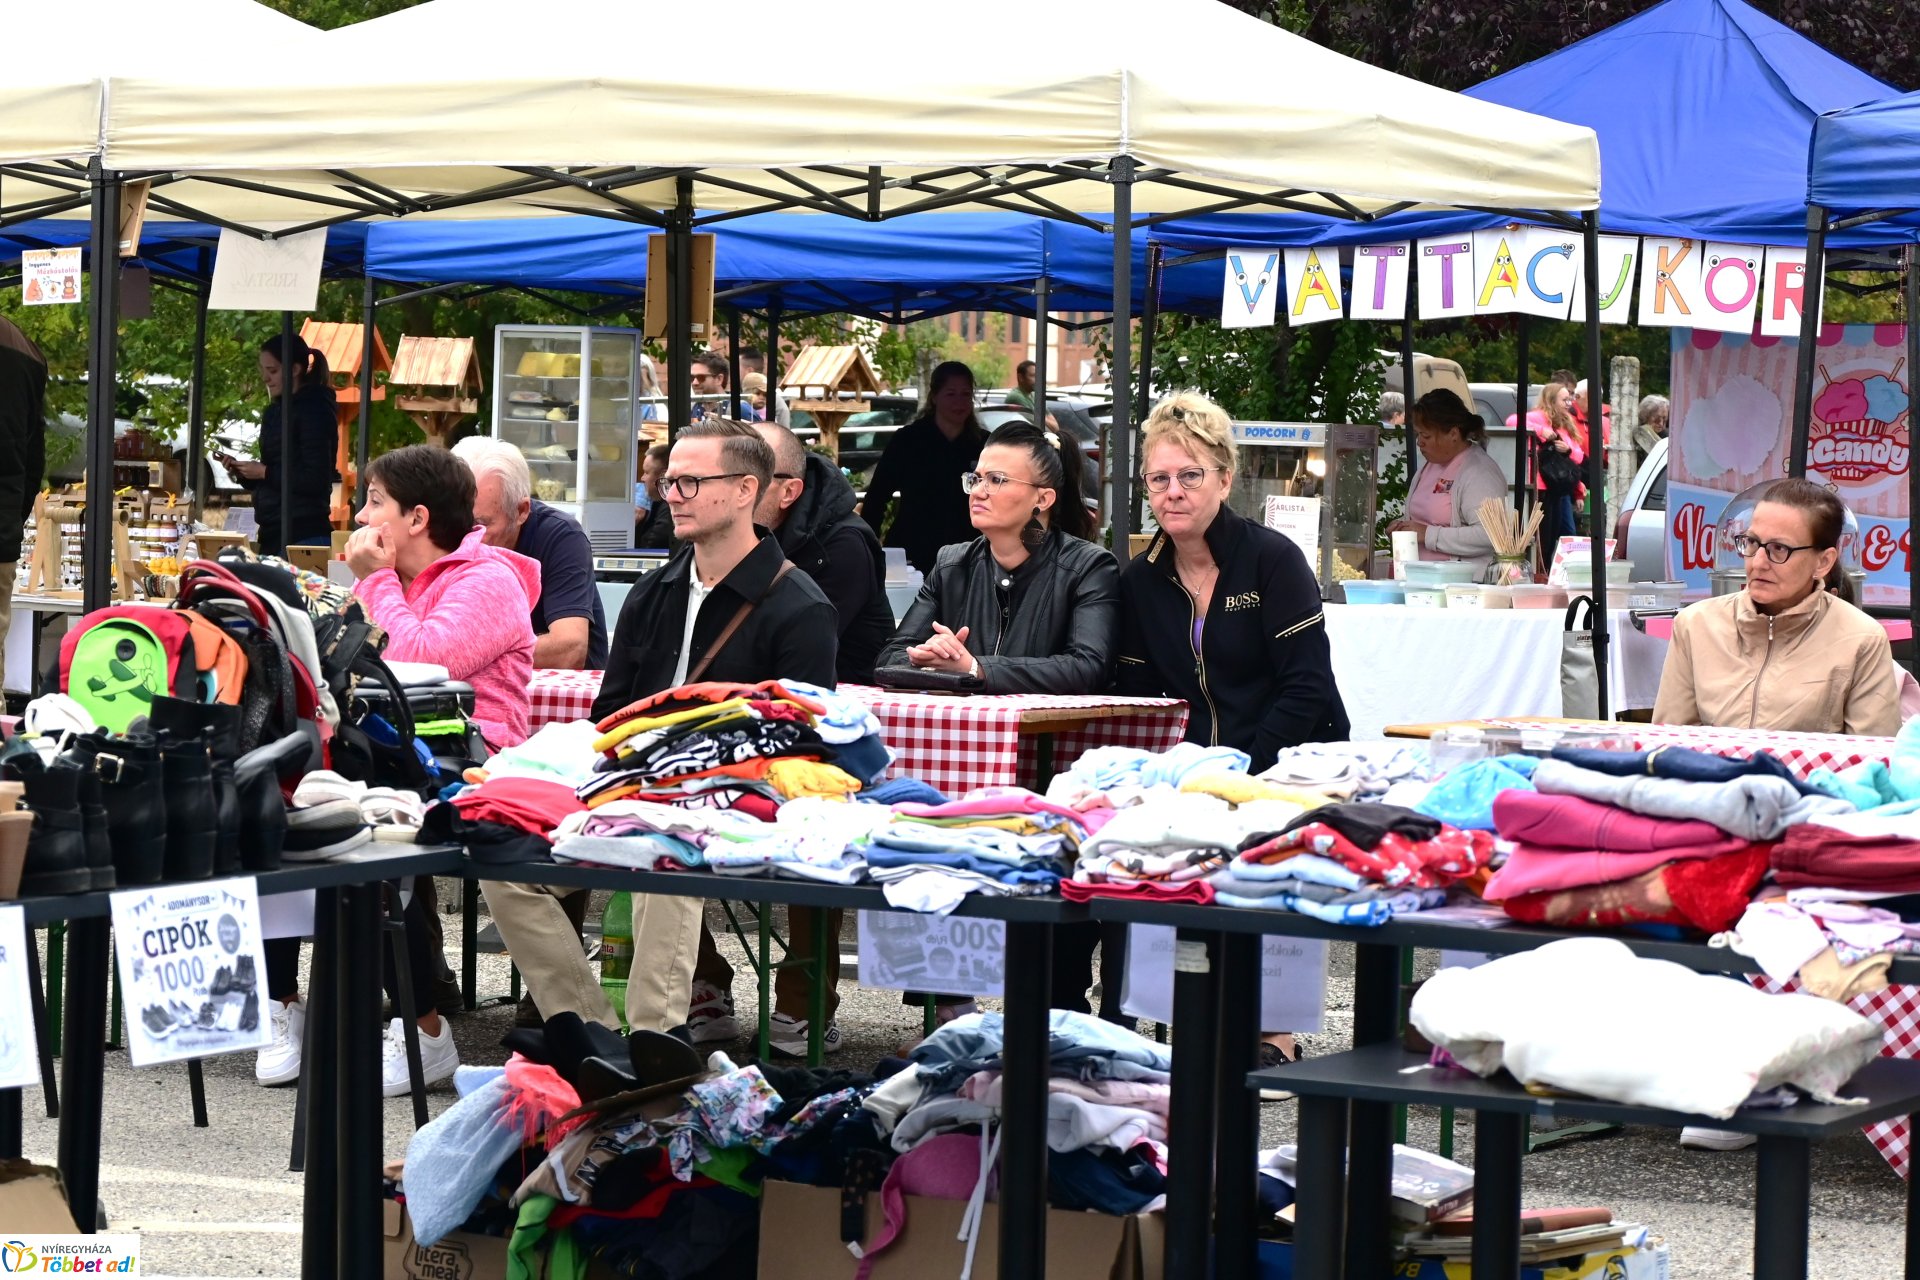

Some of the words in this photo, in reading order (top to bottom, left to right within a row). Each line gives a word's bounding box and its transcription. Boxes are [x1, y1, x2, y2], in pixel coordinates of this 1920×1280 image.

[1229, 236, 1806, 321] VATTACUKOR
[1245, 427, 1296, 438] POPCORN
[1225, 591, 1260, 608] BOSS
[142, 916, 213, 958] CIPŐK
[153, 955, 205, 993] 1000
[421, 1263, 461, 1280] meat
